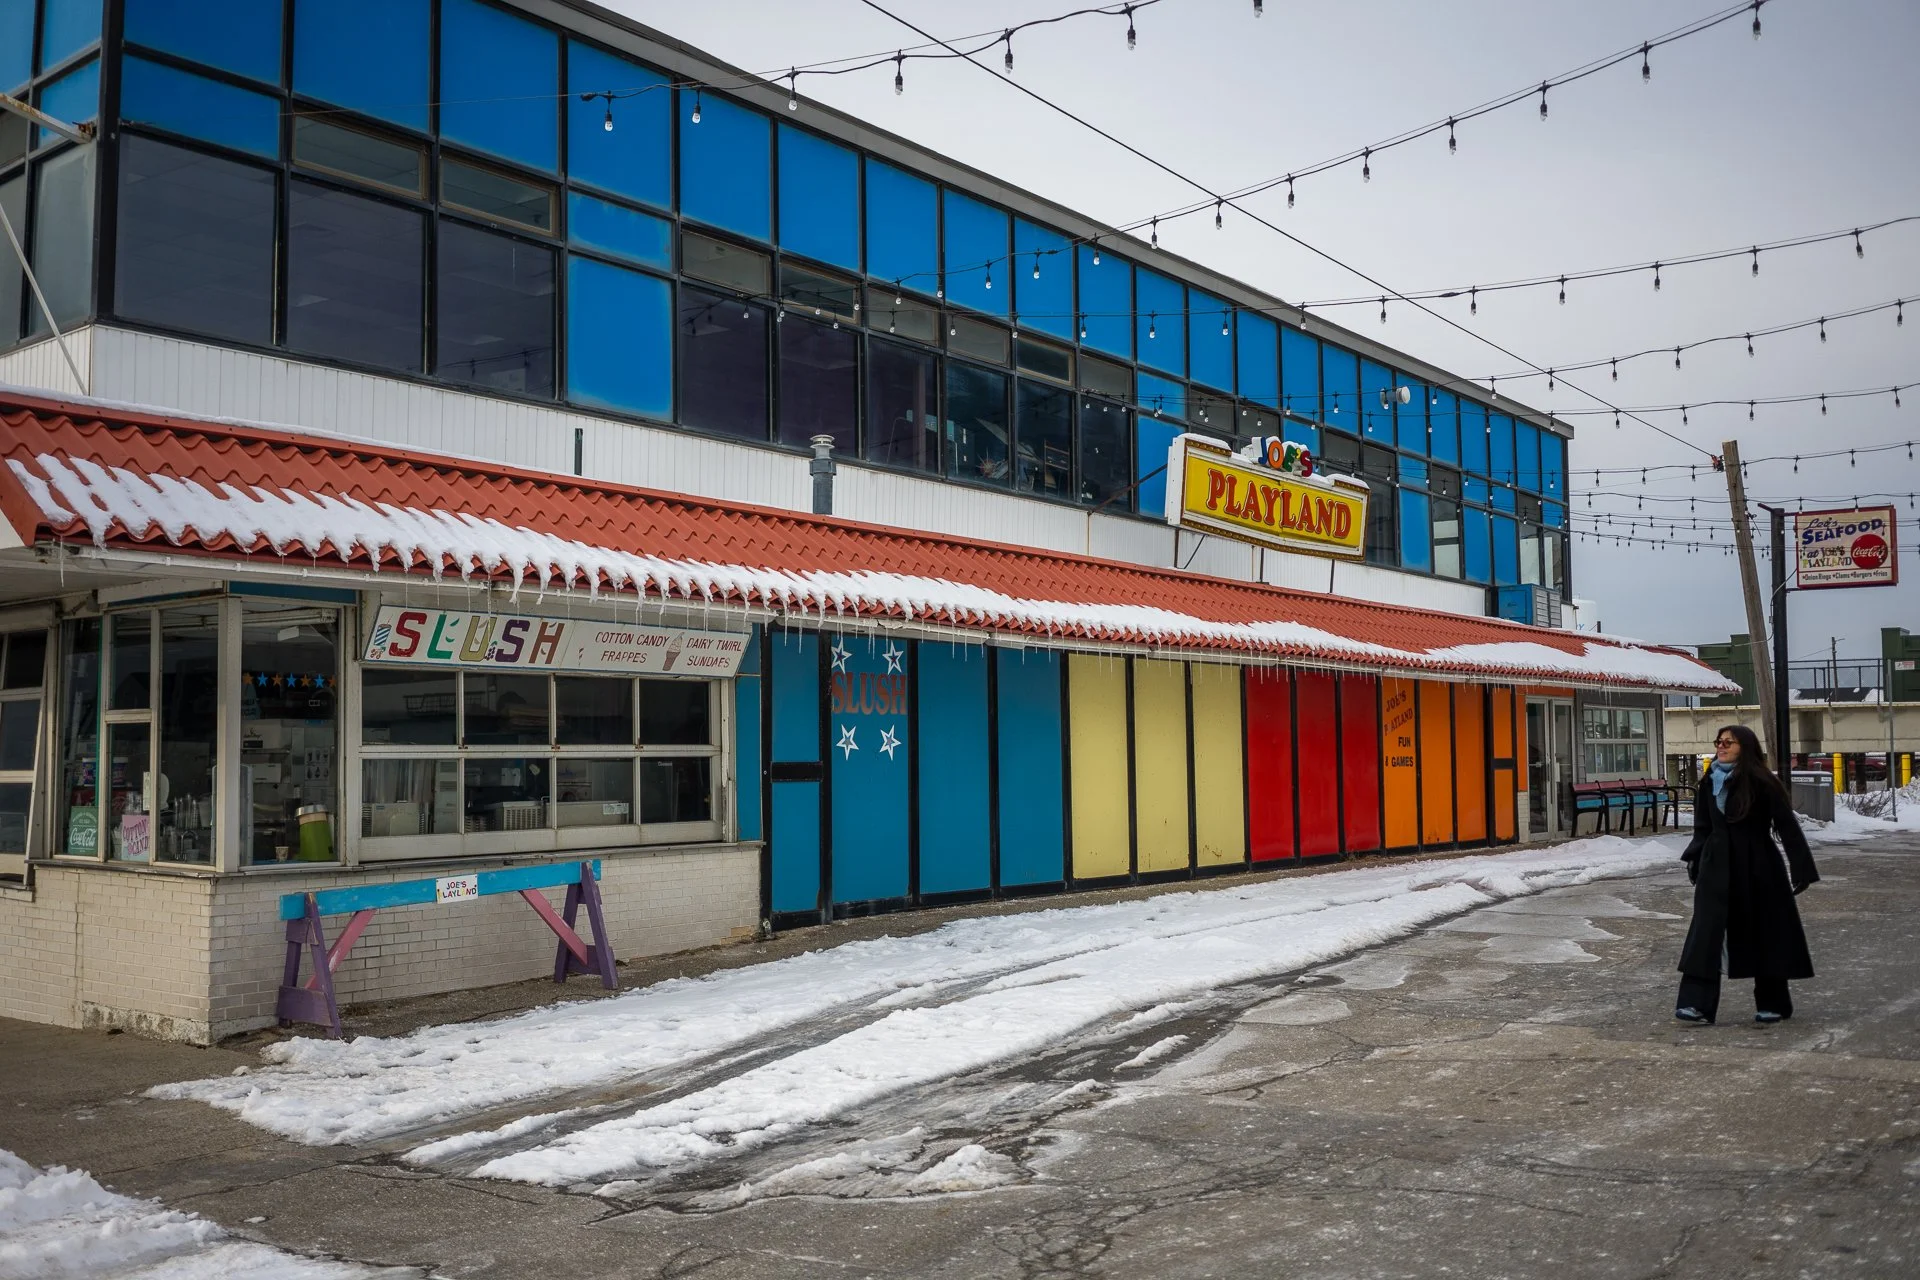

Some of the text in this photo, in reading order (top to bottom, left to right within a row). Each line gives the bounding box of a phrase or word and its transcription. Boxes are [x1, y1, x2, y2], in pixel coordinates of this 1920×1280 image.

[1257, 436, 1313, 477] JOE'S
[1206, 468, 1351, 539] PLAYLAND
[1802, 519, 1883, 545] SEAFOOD
[1807, 550, 1819, 558] at
[1802, 557, 1852, 568] PLAYLAND
[389, 611, 565, 664] SLUSH
[595, 632, 670, 648] COTTON CANDY
[686, 638, 743, 652] DAIRY TWIRL
[601, 651, 648, 664] FRAPPES
[687, 655, 731, 668] SUNDAES
[831, 671, 907, 716] SLUSH
[1386, 690, 1407, 713] JOE'S
[1398, 736, 1411, 748] FUN
[1391, 756, 1414, 768] GAMES
[132, 835, 149, 857] CAND
[446, 880, 467, 890] JOE'S
